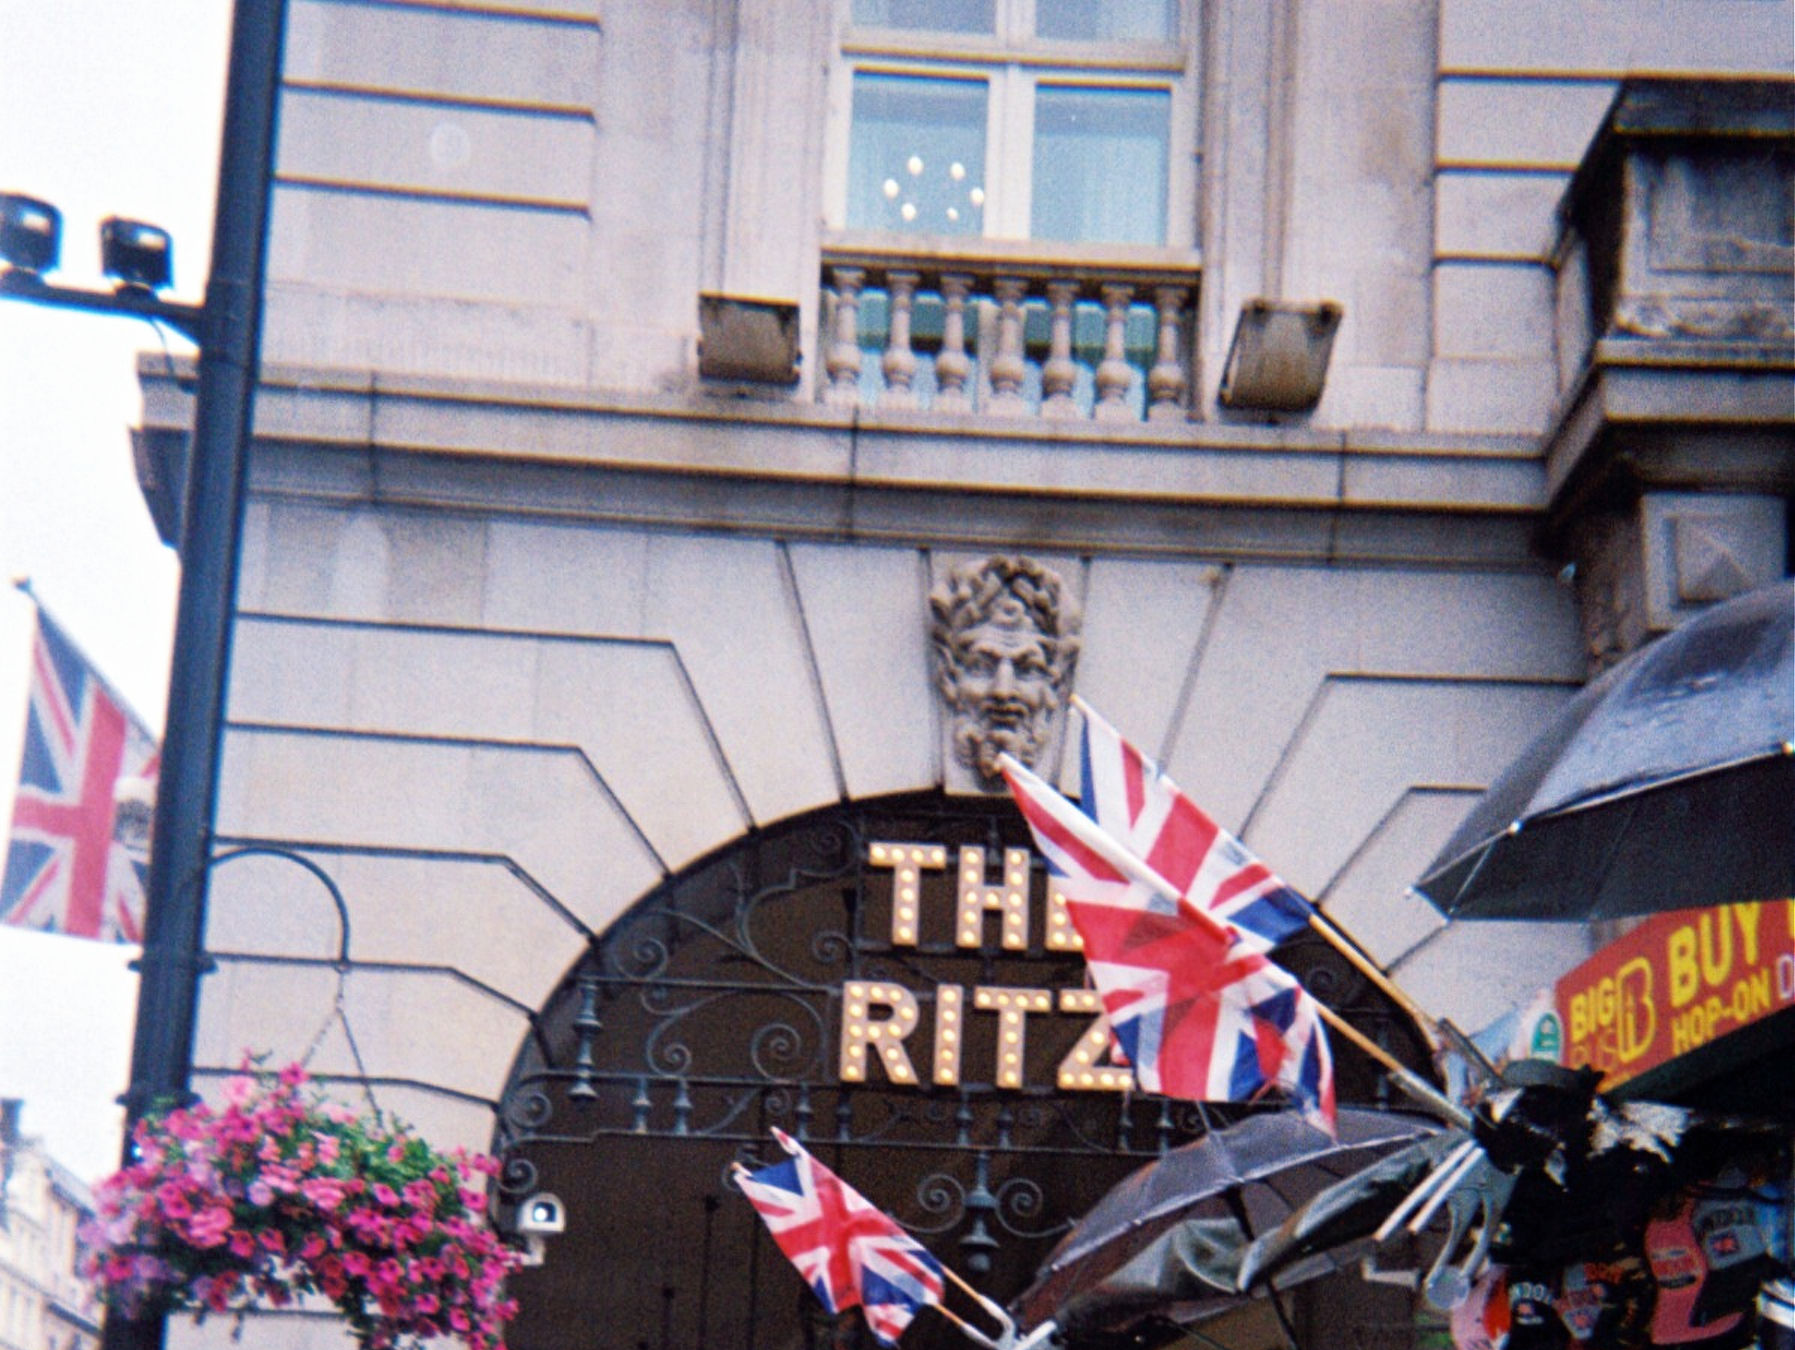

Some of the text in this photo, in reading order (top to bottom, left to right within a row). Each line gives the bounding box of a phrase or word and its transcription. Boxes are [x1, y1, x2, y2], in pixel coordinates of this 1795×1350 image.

[1667, 901, 1761, 1009] BUY
[839, 980, 1133, 1091] RITZ
[1569, 976, 1615, 1044] BIG
[1671, 966, 1772, 1057] HOP-ON
